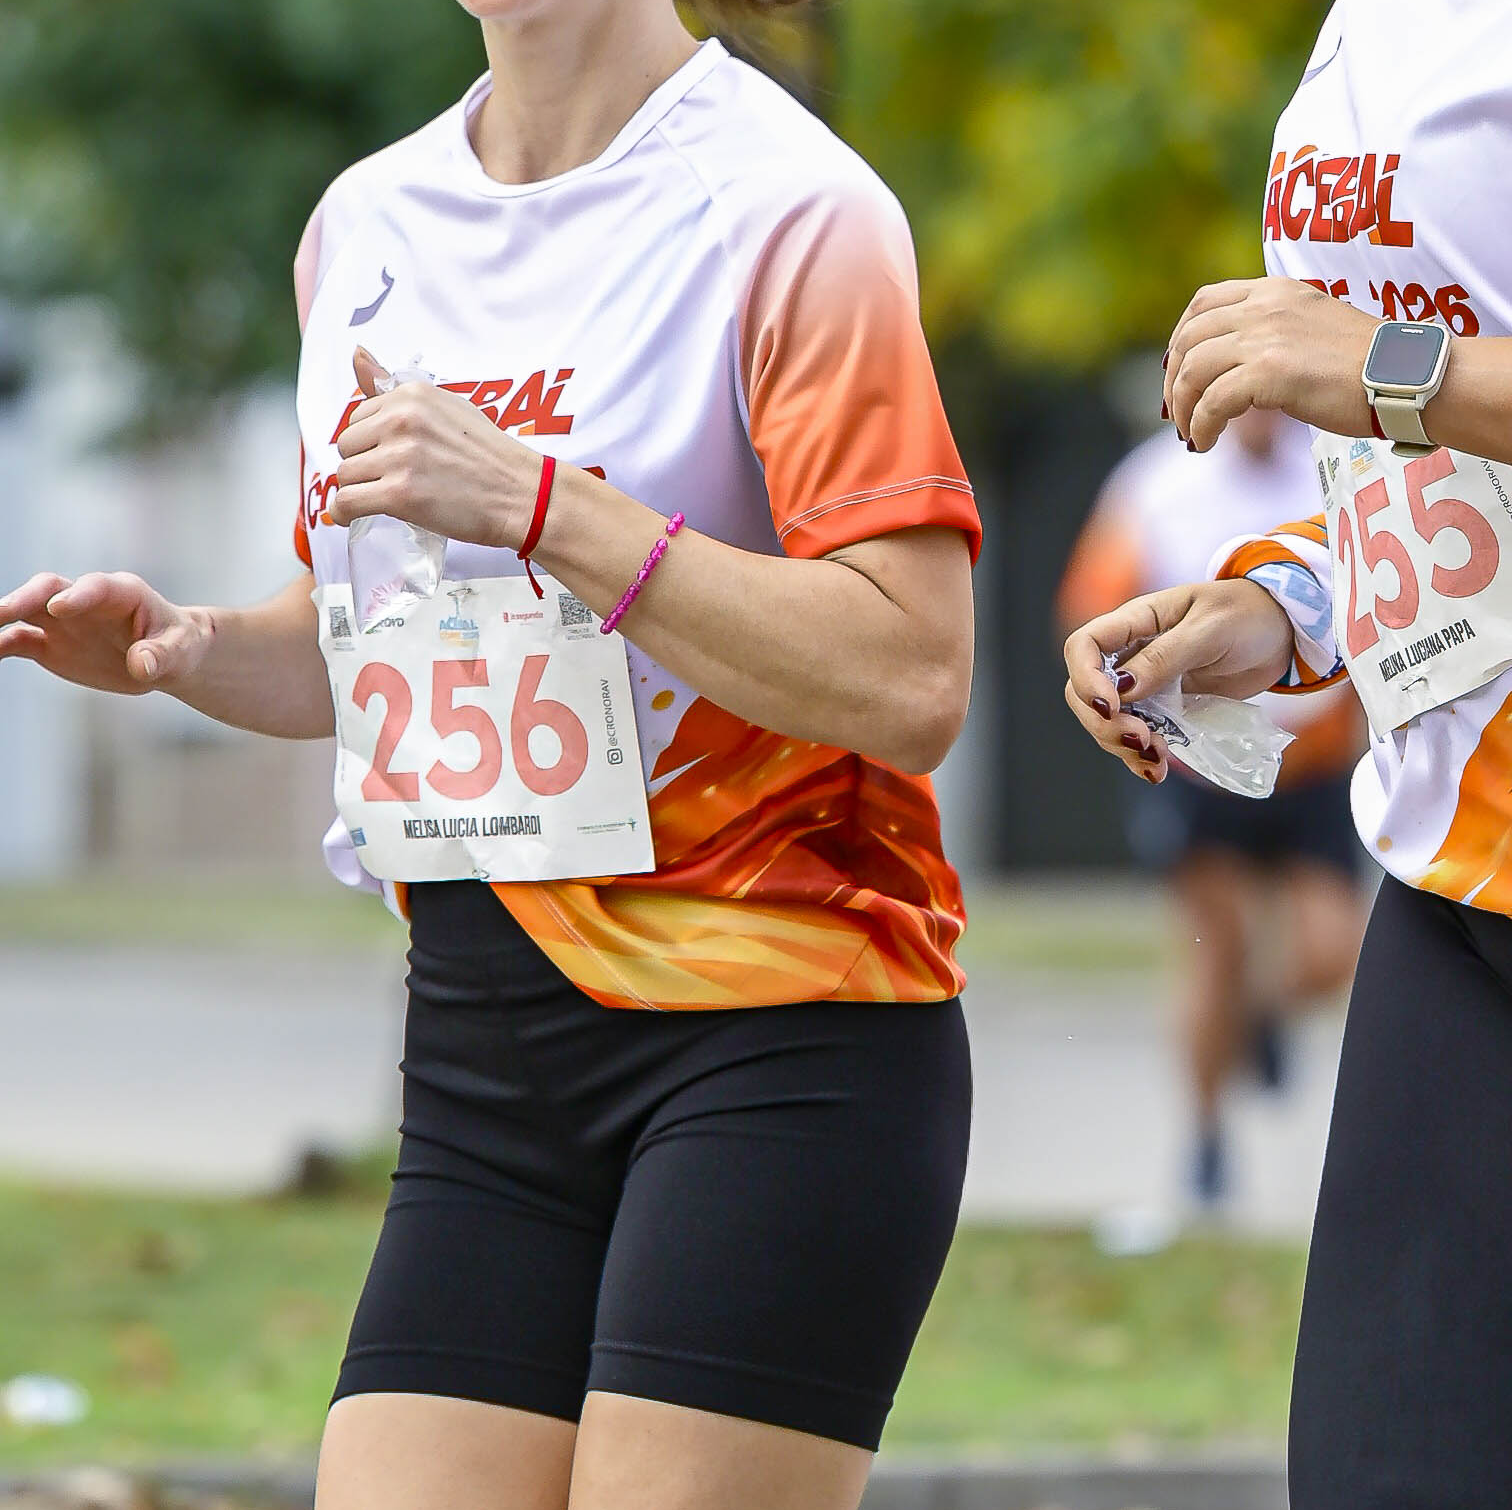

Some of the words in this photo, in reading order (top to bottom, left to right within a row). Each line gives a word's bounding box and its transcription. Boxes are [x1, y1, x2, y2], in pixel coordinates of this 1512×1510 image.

[1338, 447, 1500, 660] 255
[1440, 618, 1476, 649] PAPA
[351, 654, 589, 802] 256
[599, 679, 619, 747] @CRONORAV
[403, 819, 442, 839] MELISA
[442, 817, 479, 838] LUCIA
[482, 815, 542, 837] LOMBARDI
